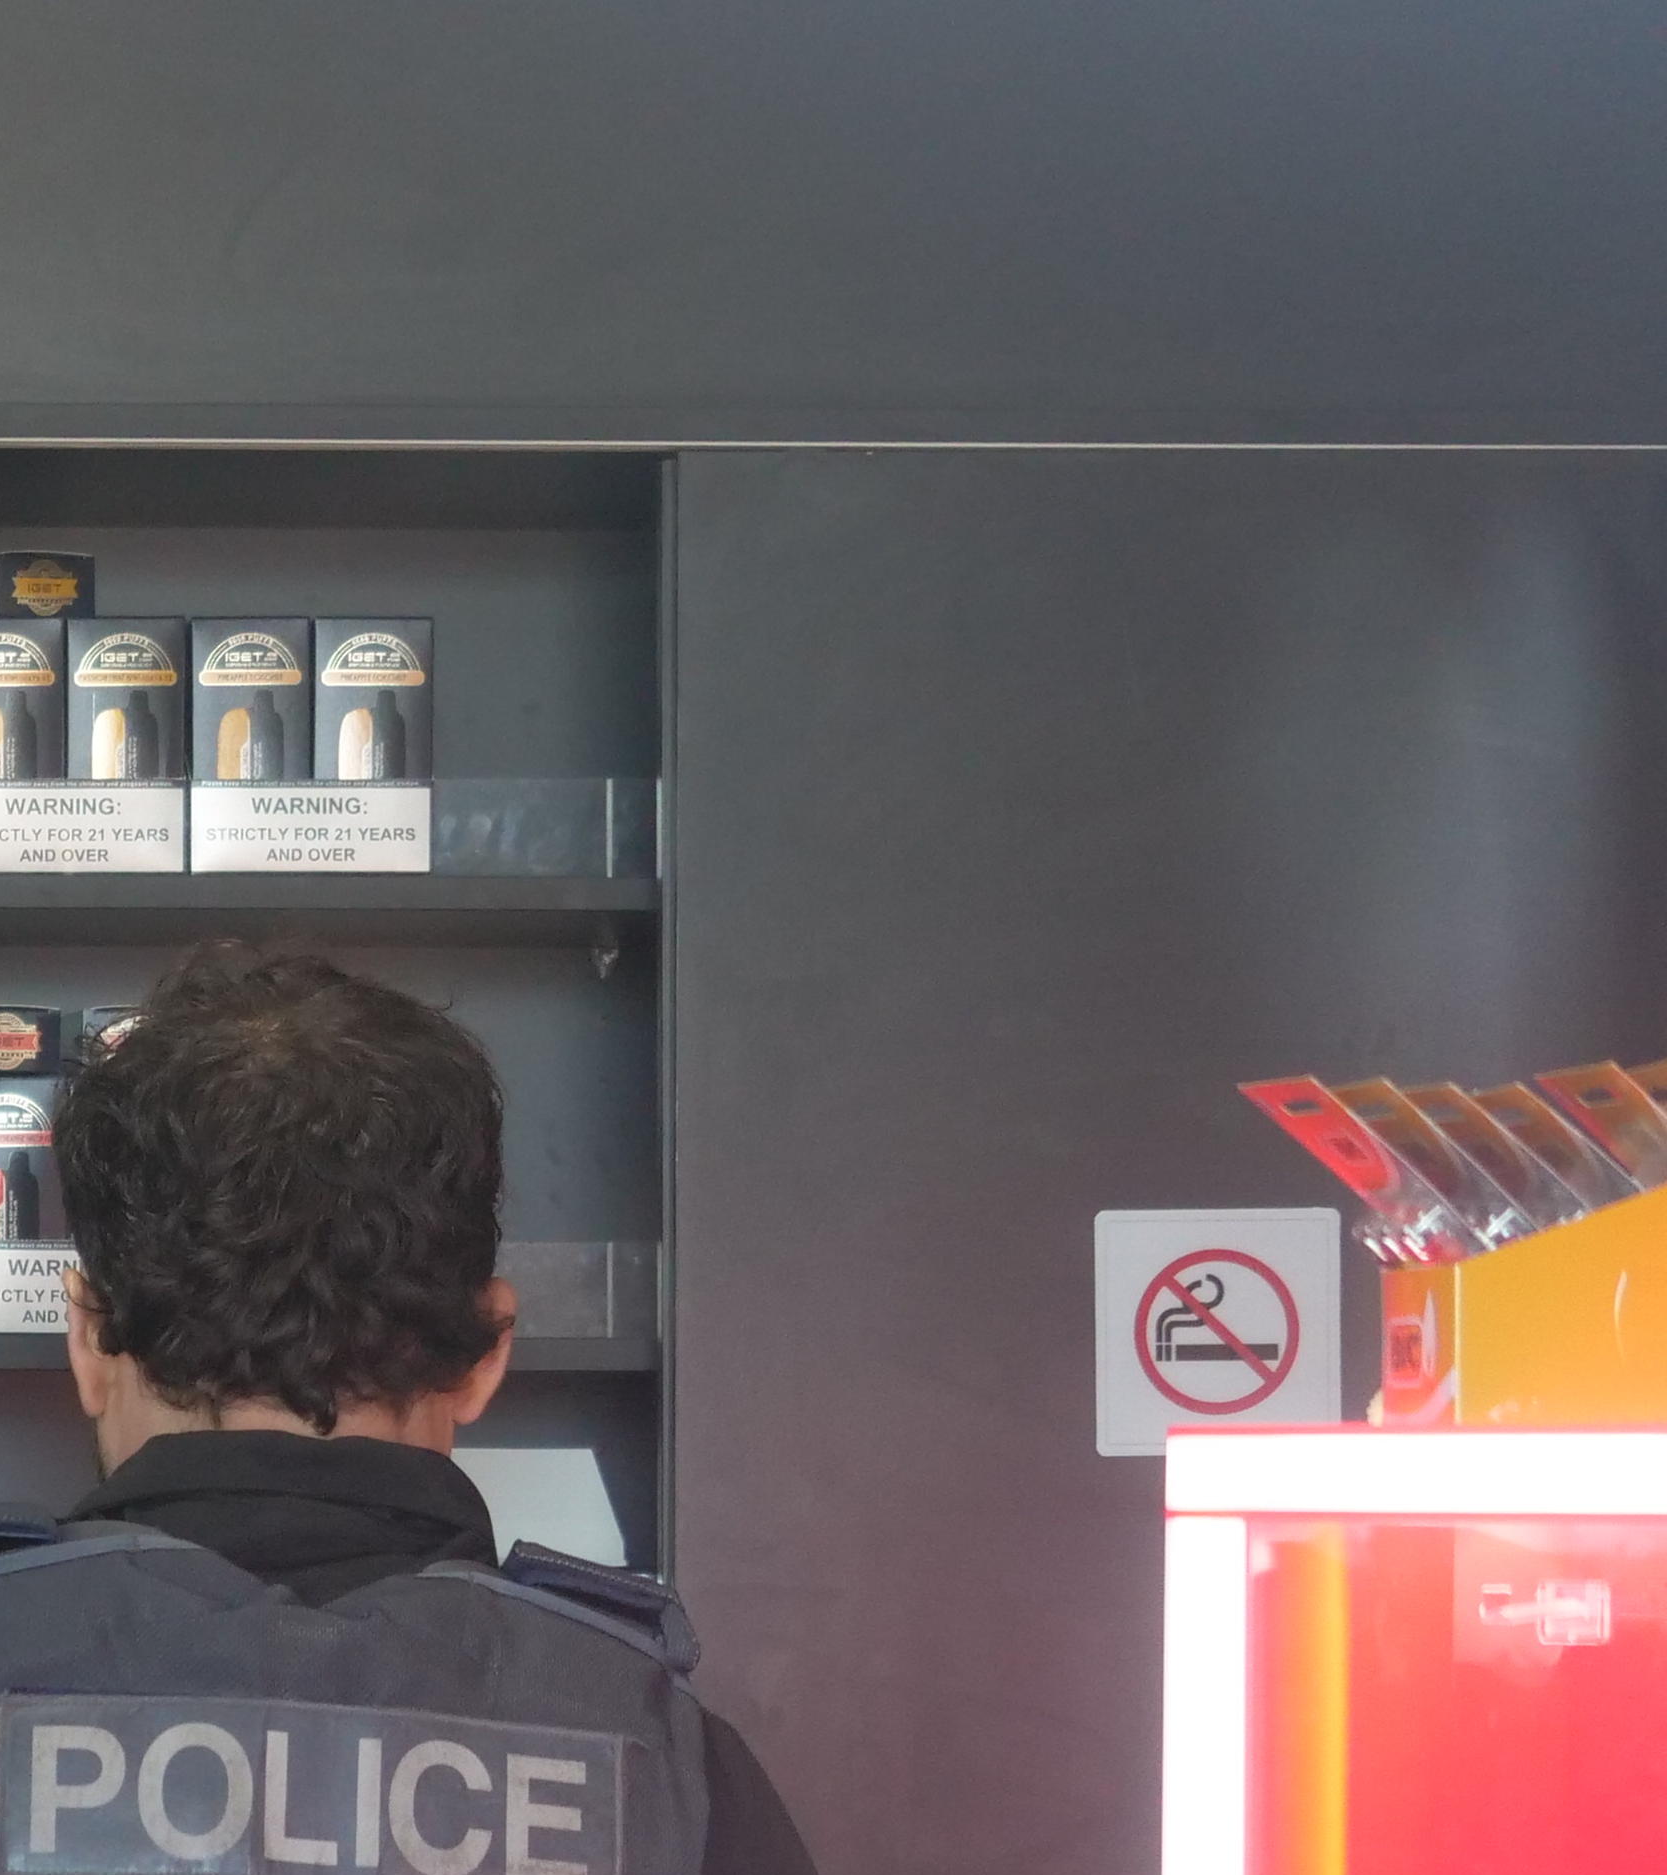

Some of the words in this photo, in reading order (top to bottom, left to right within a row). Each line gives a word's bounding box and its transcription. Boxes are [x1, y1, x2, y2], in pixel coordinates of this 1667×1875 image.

[5, 797, 121, 816] WARNING:
[251, 797, 368, 815] WARNING:
[47, 828, 83, 843] FOR
[88, 828, 105, 843] 21
[111, 828, 169, 843] YEARS
[205, 827, 289, 842] STRICTLY
[294, 827, 329, 842] FOR
[334, 827, 352, 842] 21
[358, 827, 416, 842] YEARS
[19, 849, 56, 863] AND
[61, 849, 109, 863] OVER
[266, 848, 303, 862] AND
[307, 848, 355, 862] OVER
[8, 1259, 77, 1276] WARN
[22, 1310, 59, 1323] AND
